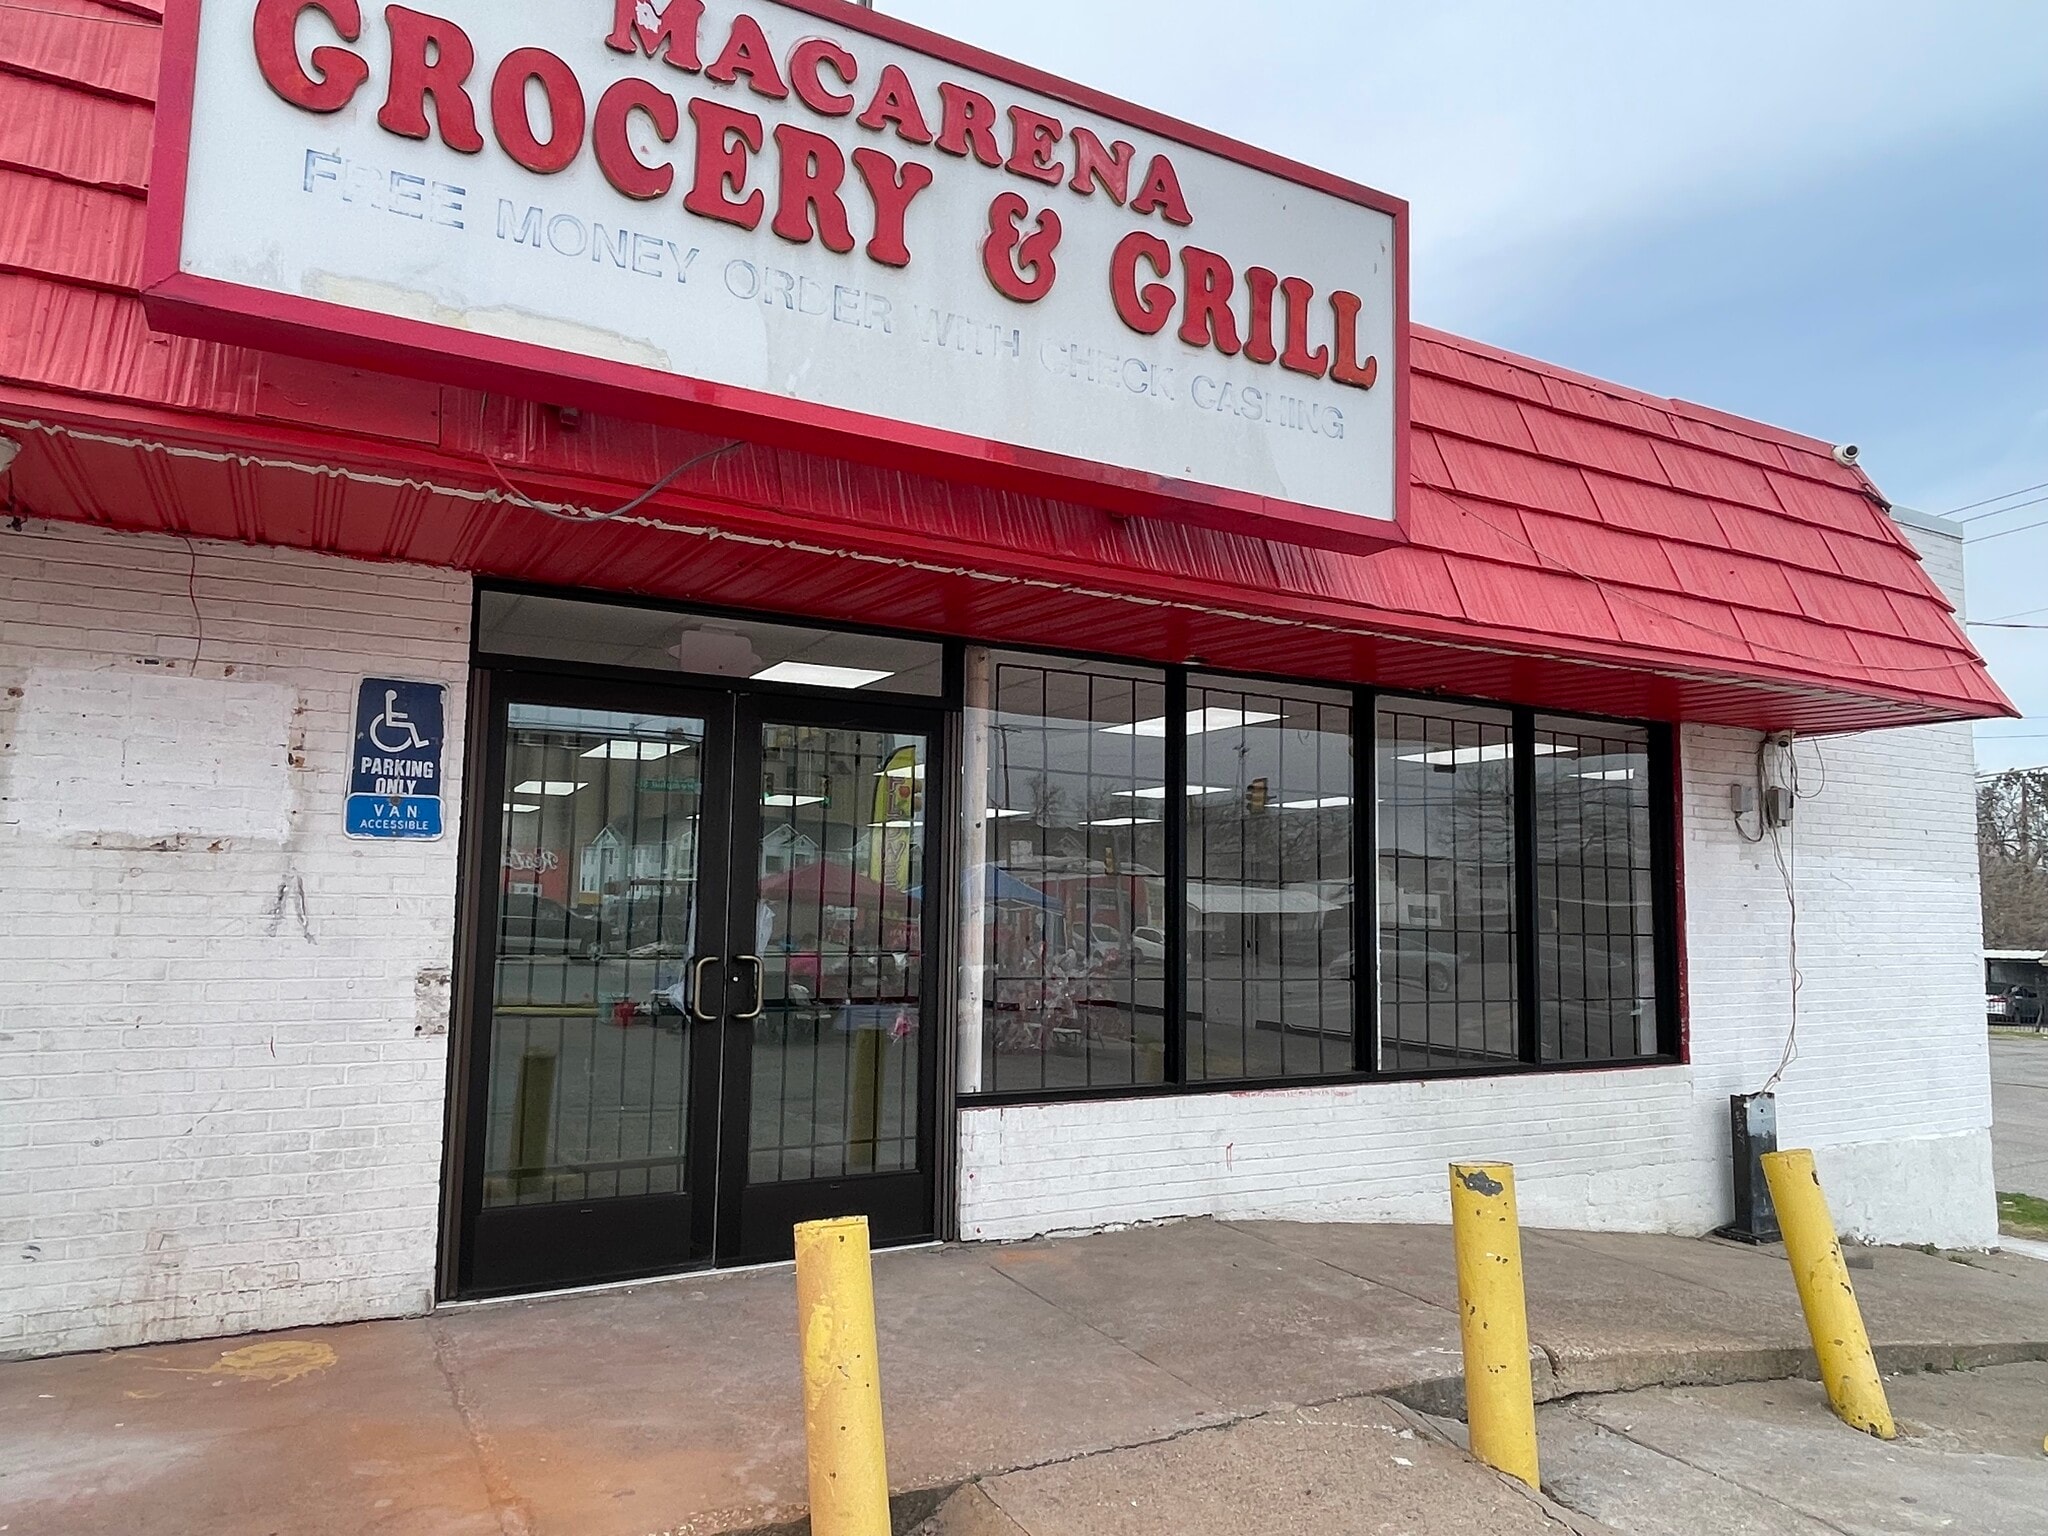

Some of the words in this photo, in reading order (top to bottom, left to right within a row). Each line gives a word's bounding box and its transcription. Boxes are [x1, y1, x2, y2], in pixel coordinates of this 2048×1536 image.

[605, 0, 1193, 226] MACARENA
[253, 0, 933, 268] GROCERY
[983, 191, 1062, 303] &
[1110, 231, 1377, 390] GRILL
[303, 149, 466, 230] FREE
[496, 198, 700, 284] MONEY
[724, 258, 892, 334] ORDER
[914, 303, 1020, 357] WITH
[1040, 343, 1176, 401] CHECK
[1191, 374, 1344, 439] CASHING
[359, 819, 430, 831] ACCESSIBLE
[360, 756, 434, 779] PARKING
[374, 777, 417, 796] ONLY
